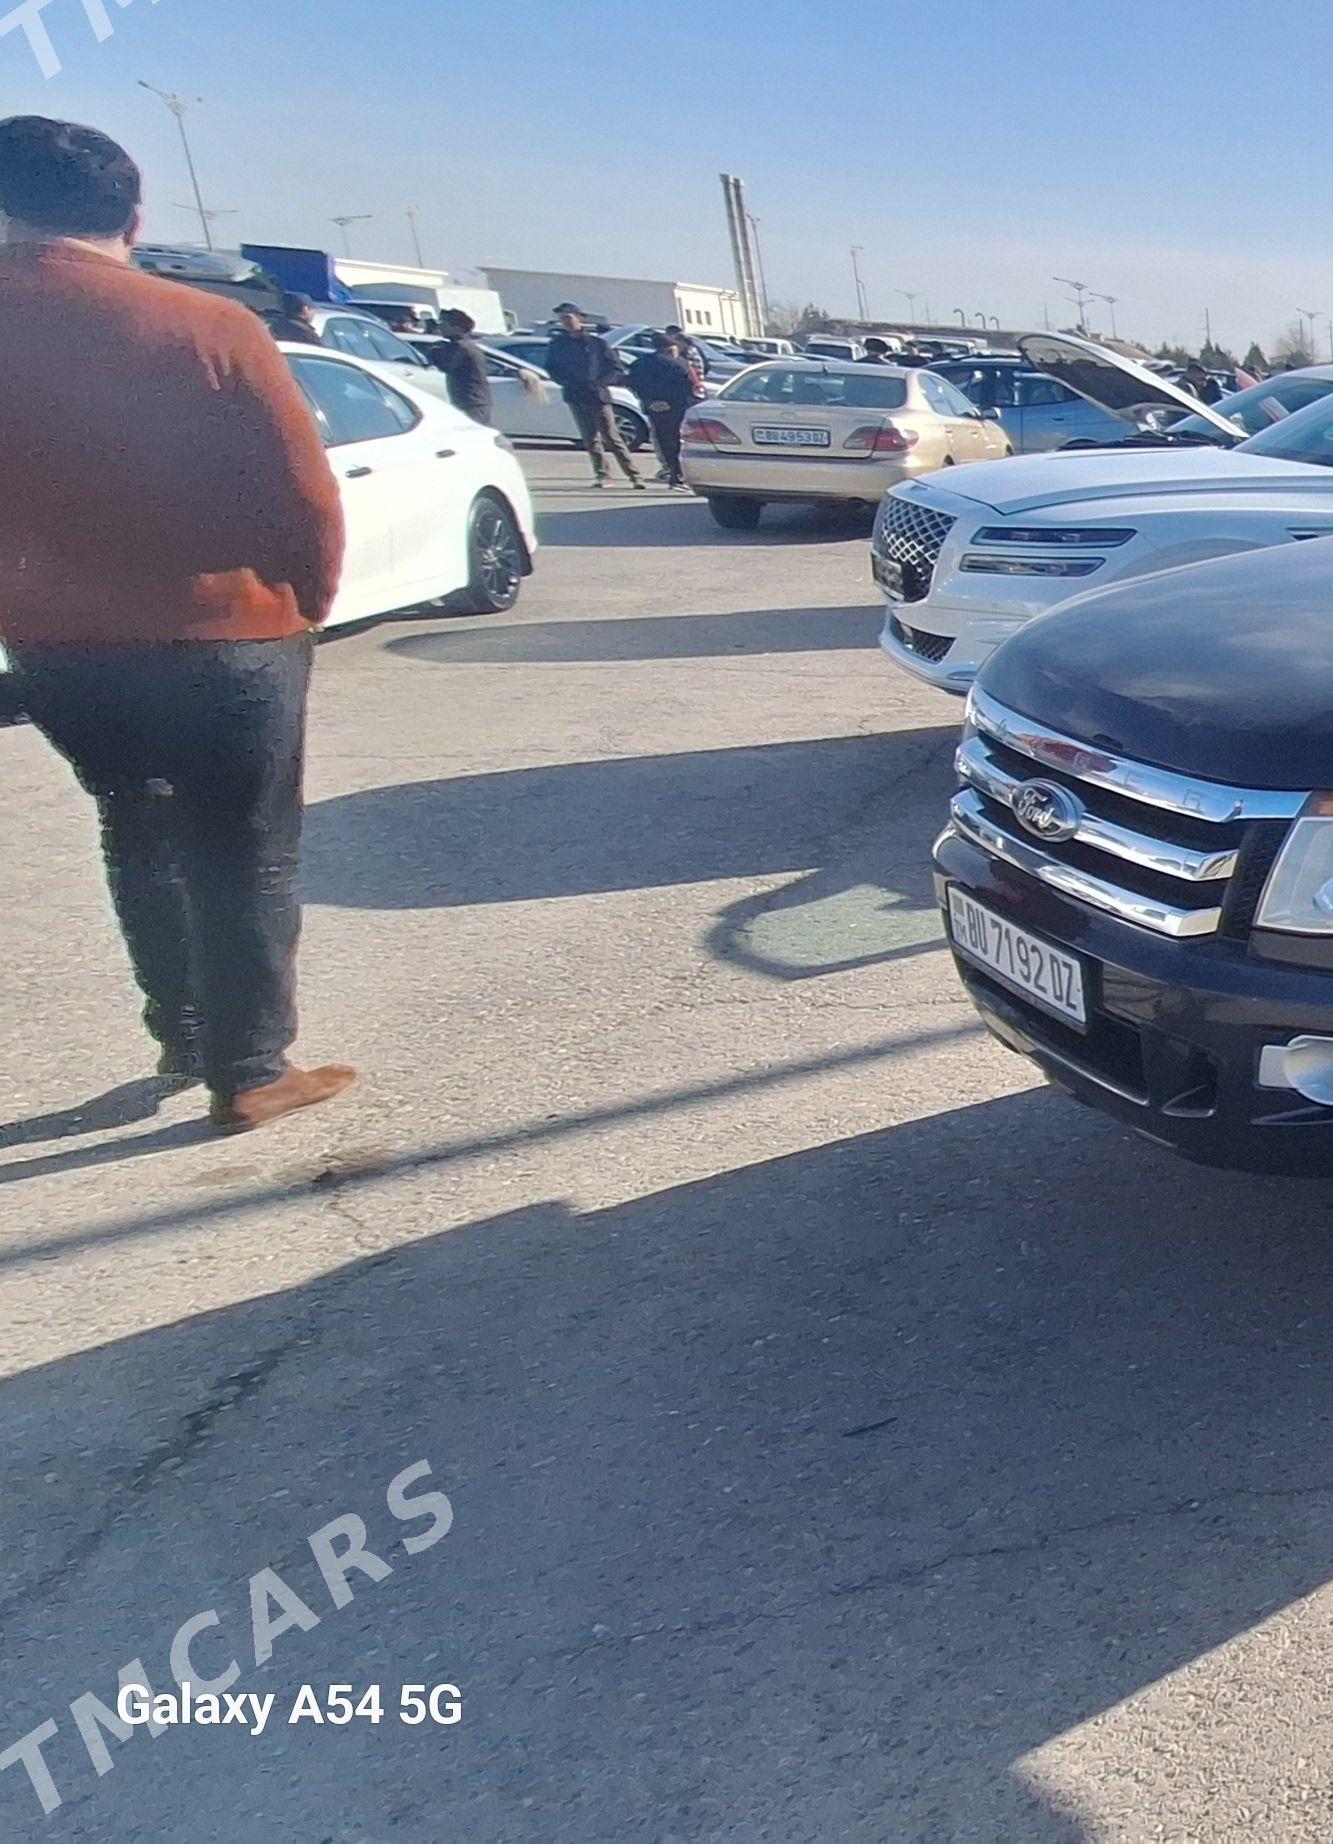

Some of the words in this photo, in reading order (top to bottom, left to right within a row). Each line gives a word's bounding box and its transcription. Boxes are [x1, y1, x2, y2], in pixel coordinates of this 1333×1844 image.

[1018, 787, 1055, 829] Ford
[966, 902, 988, 955] BU
[990, 918, 1047, 994] 7192
[1049, 953, 1077, 1011] DZ
